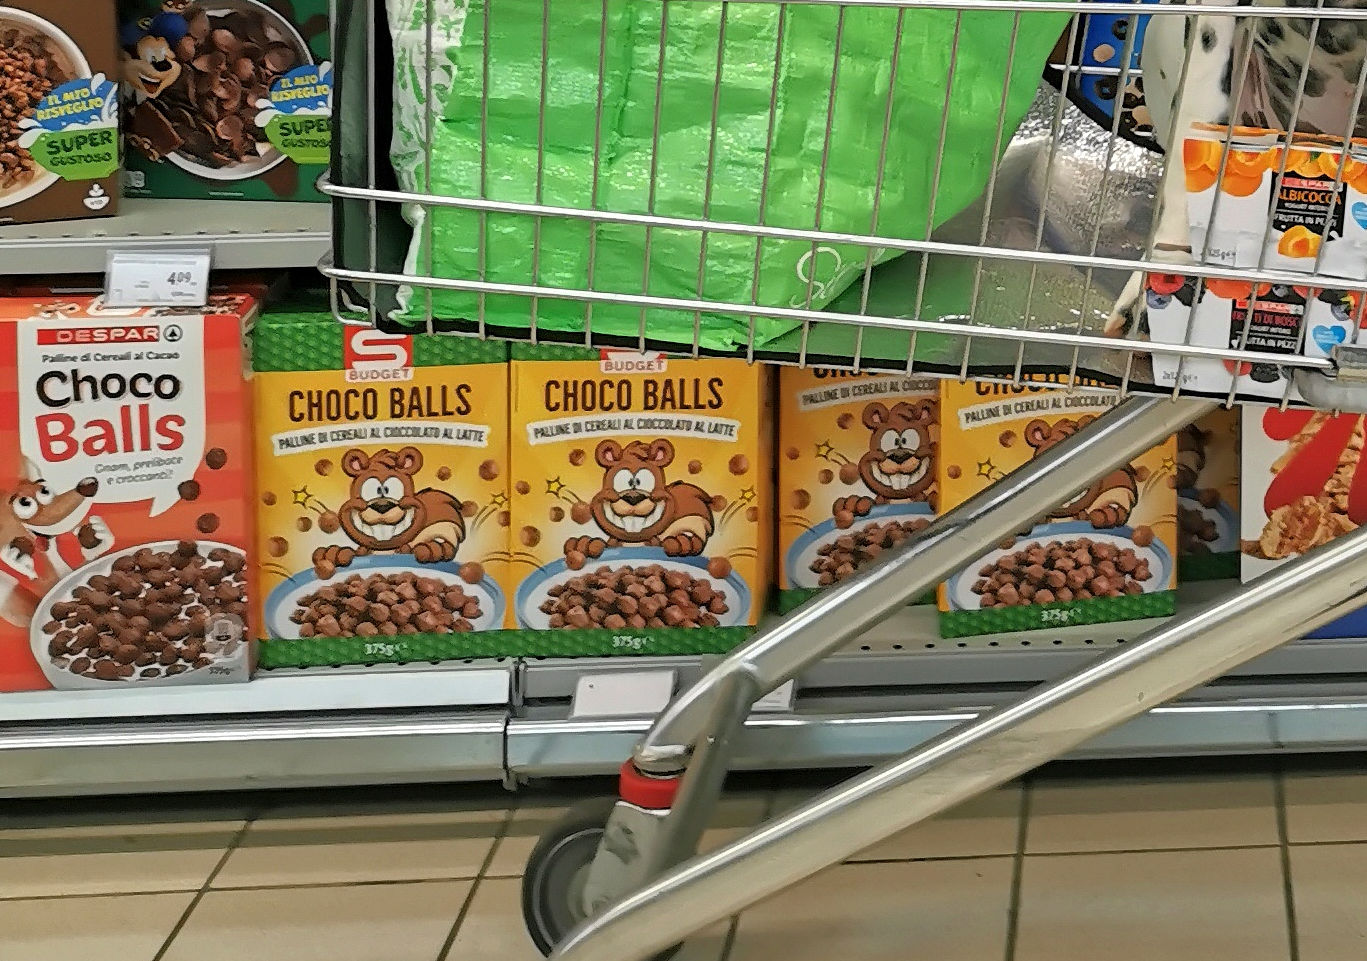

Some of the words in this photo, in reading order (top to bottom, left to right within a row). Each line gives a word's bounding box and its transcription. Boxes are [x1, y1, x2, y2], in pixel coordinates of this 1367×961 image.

[47, 130, 113, 155] SUPER
[50, 152, 113, 167] GUSTOSO
[56, 327, 160, 343] DESPAR
[349, 368, 411, 381] BUDGET
[604, 359, 665, 371] BUDGET
[35, 369, 181, 408] Choco
[544, 378, 632, 412] CHOCO
[642, 377, 724, 411] BALLS
[288, 387, 379, 423] CHOCO
[389, 383, 473, 419] BALLS
[964, 406, 1001, 424] PALLINE
[1002, 403, 1012, 415] DI
[1013, 398, 1050, 414] CEREALI
[1051, 396, 1063, 408] AL
[34, 403, 186, 463] Balls
[278, 434, 317, 450] PALLINE
[318, 432, 328, 442] DI
[329, 427, 368, 442] CEREALI
[370, 427, 381, 439] AL
[442, 428, 454, 440] AL
[455, 429, 485, 443] LATTE
[533, 425, 570, 439] PALLINE
[572, 423, 582, 433] DI
[584, 418, 622, 433] CEREALI
[623, 418, 635, 430] AL
[694, 420, 706, 433] AL
[707, 423, 736, 437] LATTE
